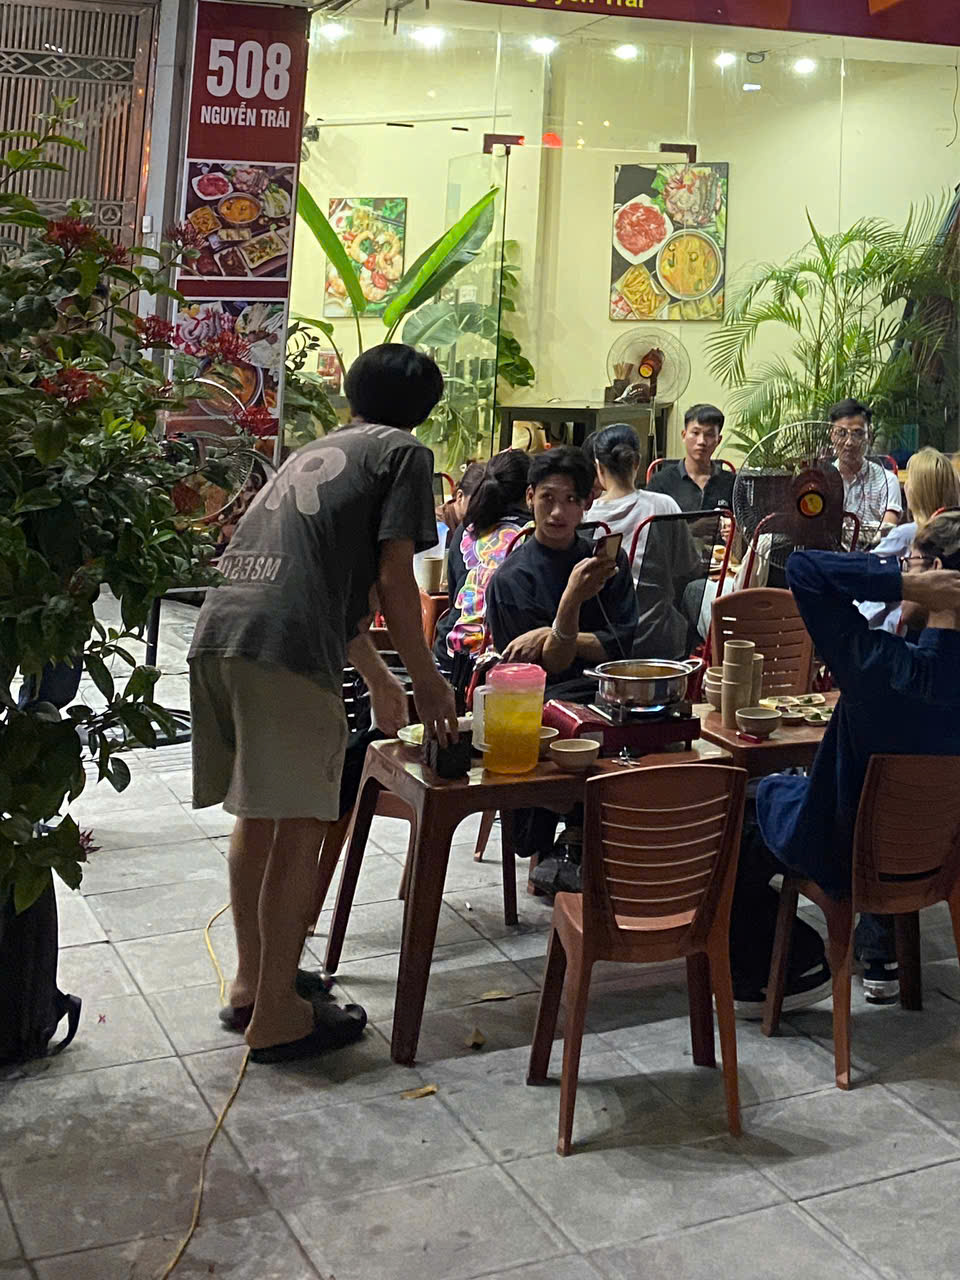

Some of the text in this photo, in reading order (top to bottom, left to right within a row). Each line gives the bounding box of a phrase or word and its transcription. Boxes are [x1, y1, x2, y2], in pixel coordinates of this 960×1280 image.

[206, 38, 292, 101] 508
[200, 102, 290, 128] NGUYỄN TRÃI
